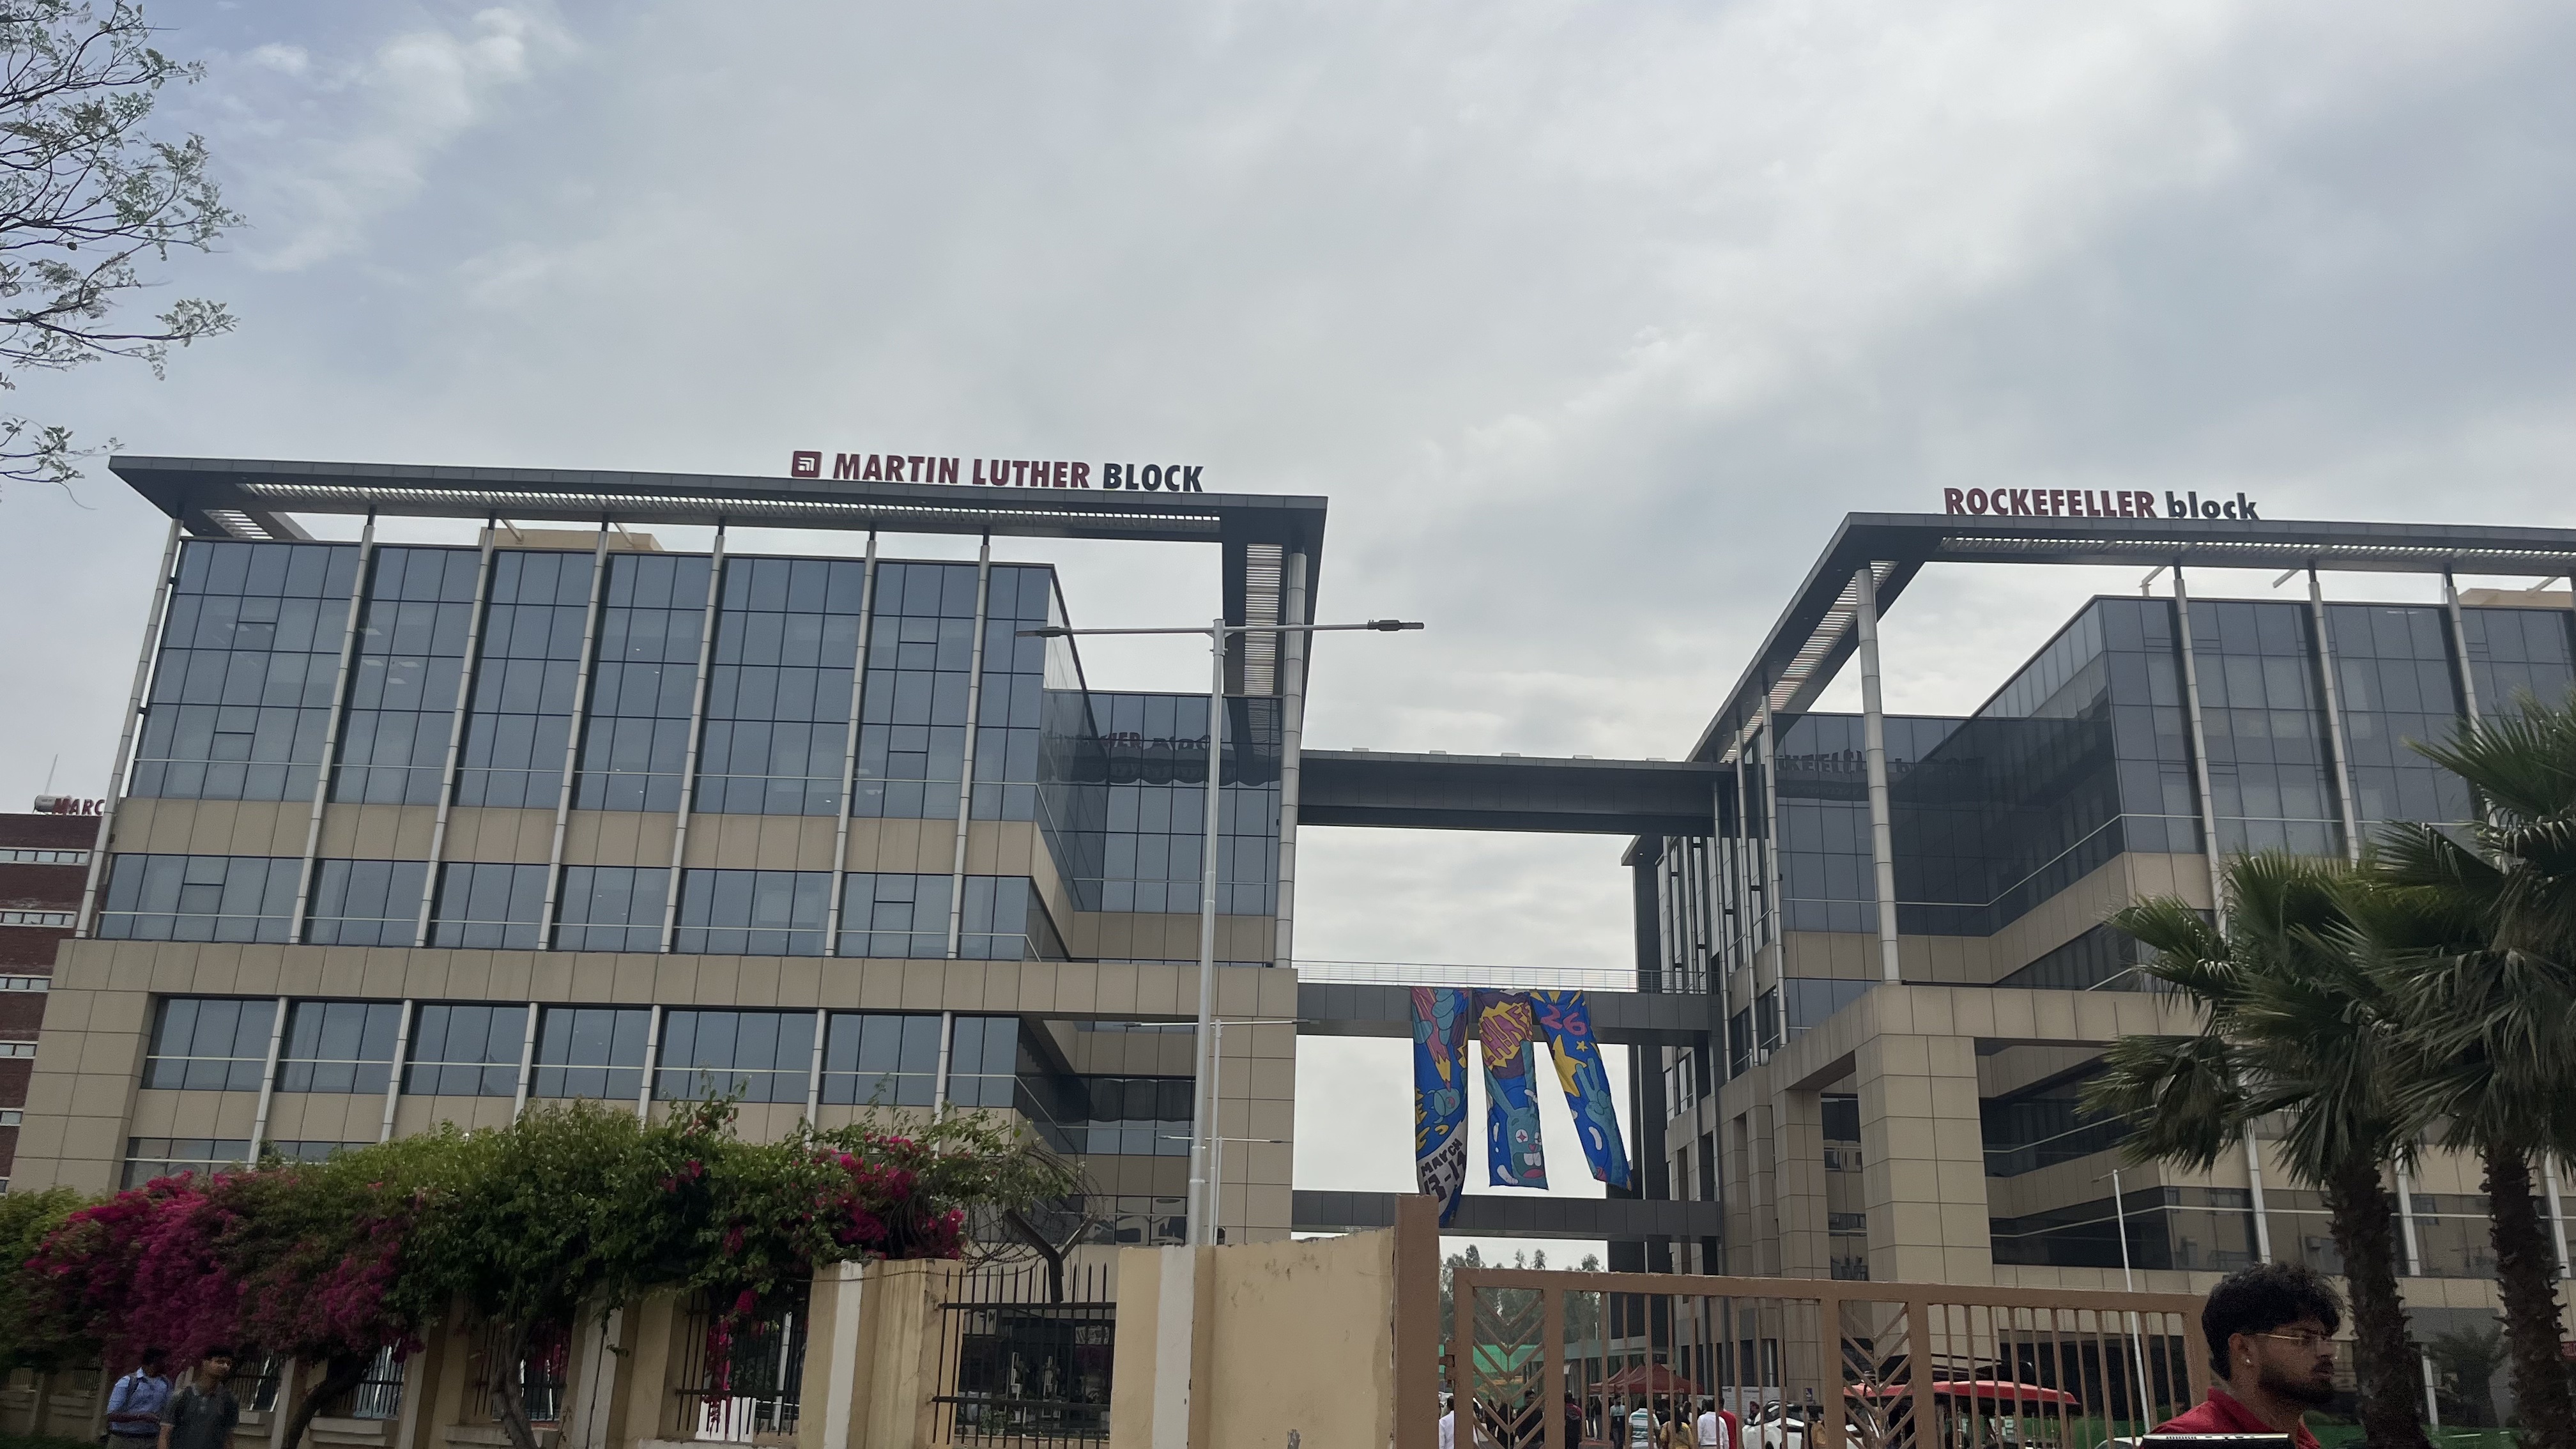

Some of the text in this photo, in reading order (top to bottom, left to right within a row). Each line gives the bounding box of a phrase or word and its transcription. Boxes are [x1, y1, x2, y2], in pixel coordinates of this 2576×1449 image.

[832, 453, 1204, 493] MARTIN LUTHER BLOCK
[1943, 487, 2260, 521] ROCKEFELLER block
[1540, 1004, 1587, 1036] 26
